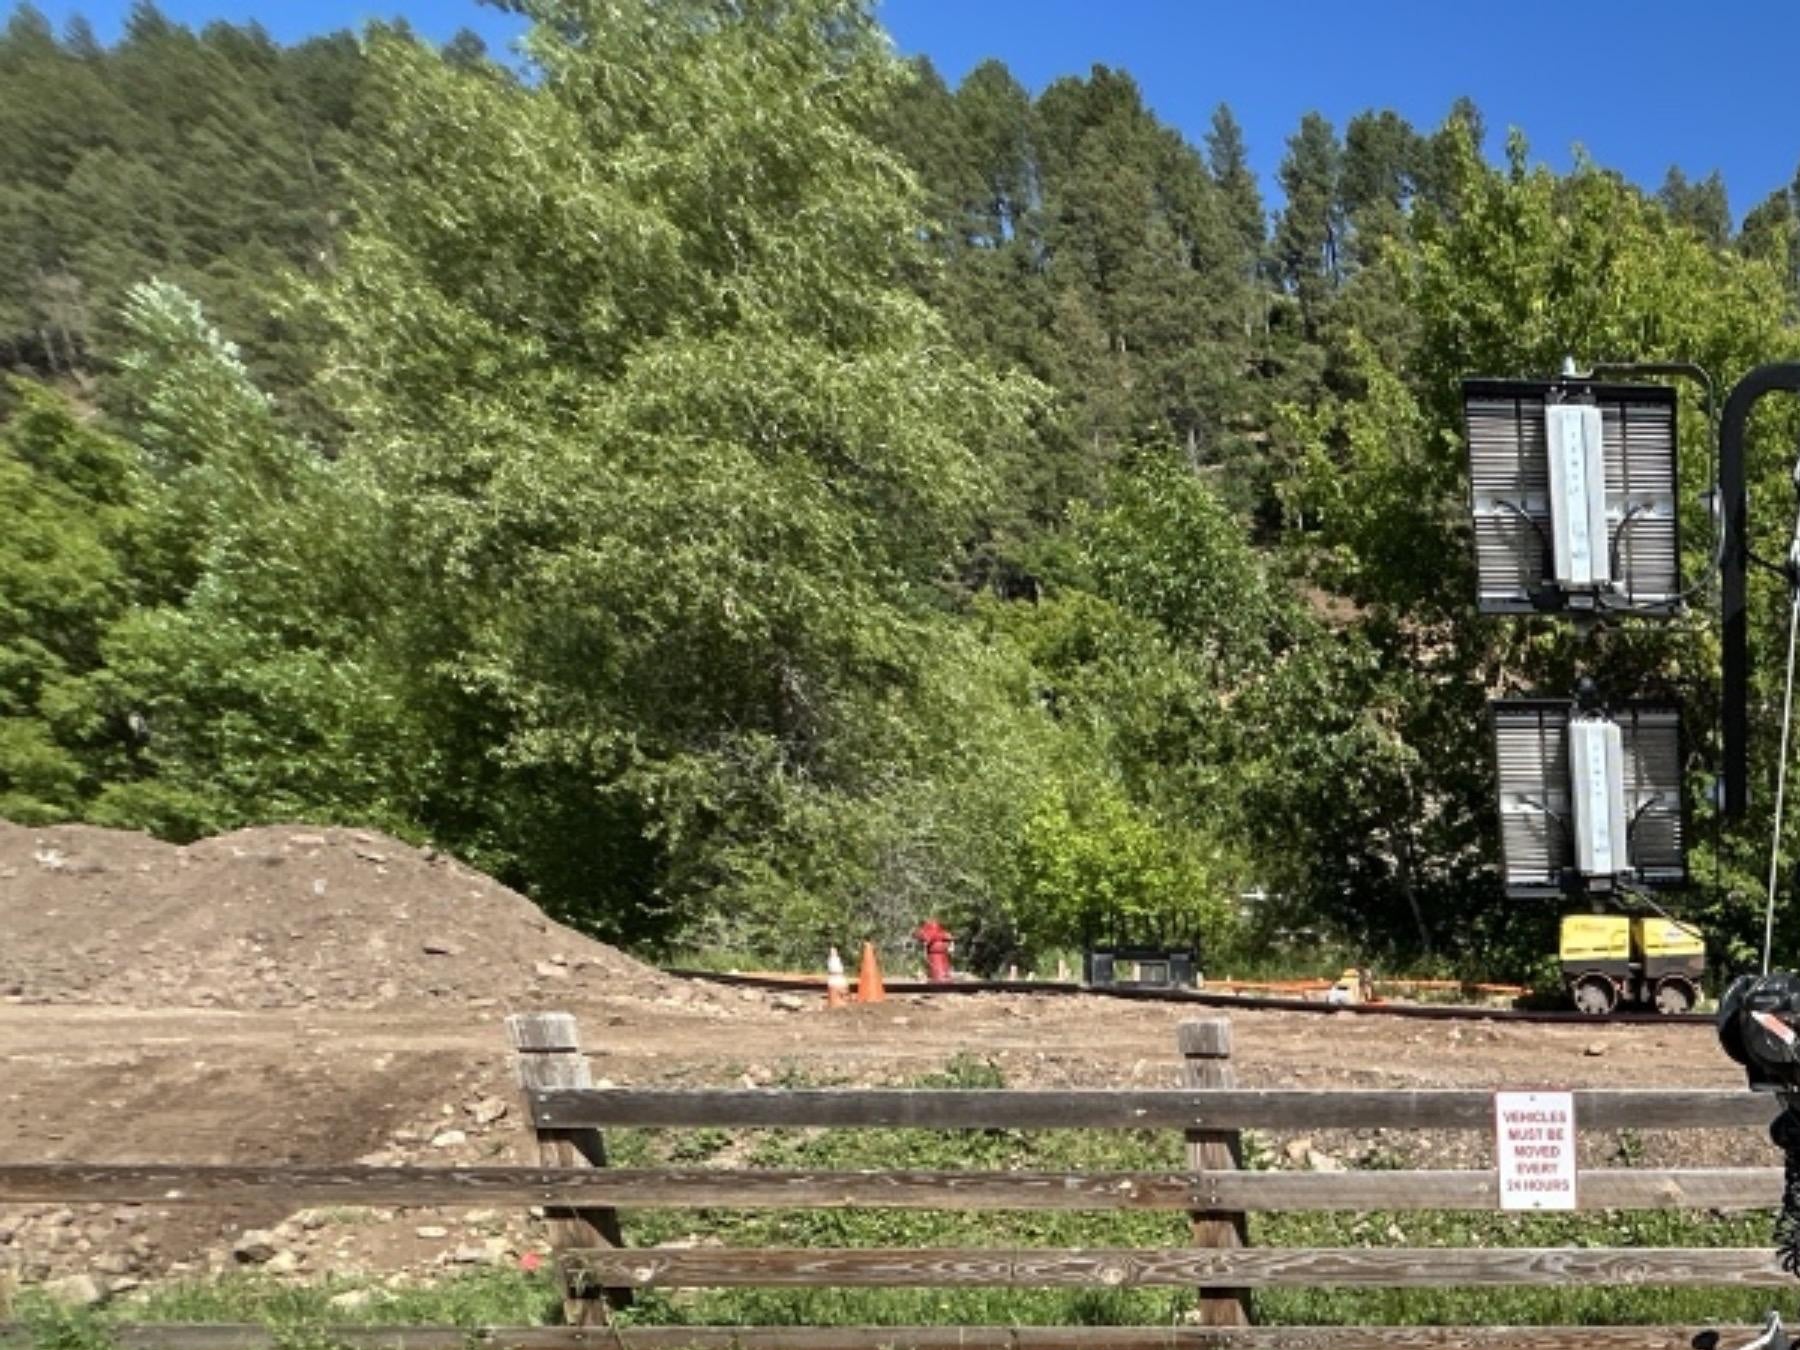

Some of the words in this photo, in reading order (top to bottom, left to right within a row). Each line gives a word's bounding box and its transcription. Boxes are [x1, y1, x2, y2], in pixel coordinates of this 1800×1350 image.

[1503, 1110, 1567, 1123] VEHICLES
[1508, 1128, 1543, 1141] MUST
[1547, 1128, 1564, 1141] BE
[1514, 1145, 1561, 1159] MOVED
[1517, 1163, 1558, 1175] EVERY
[1524, 1179, 1570, 1192] HOURS
